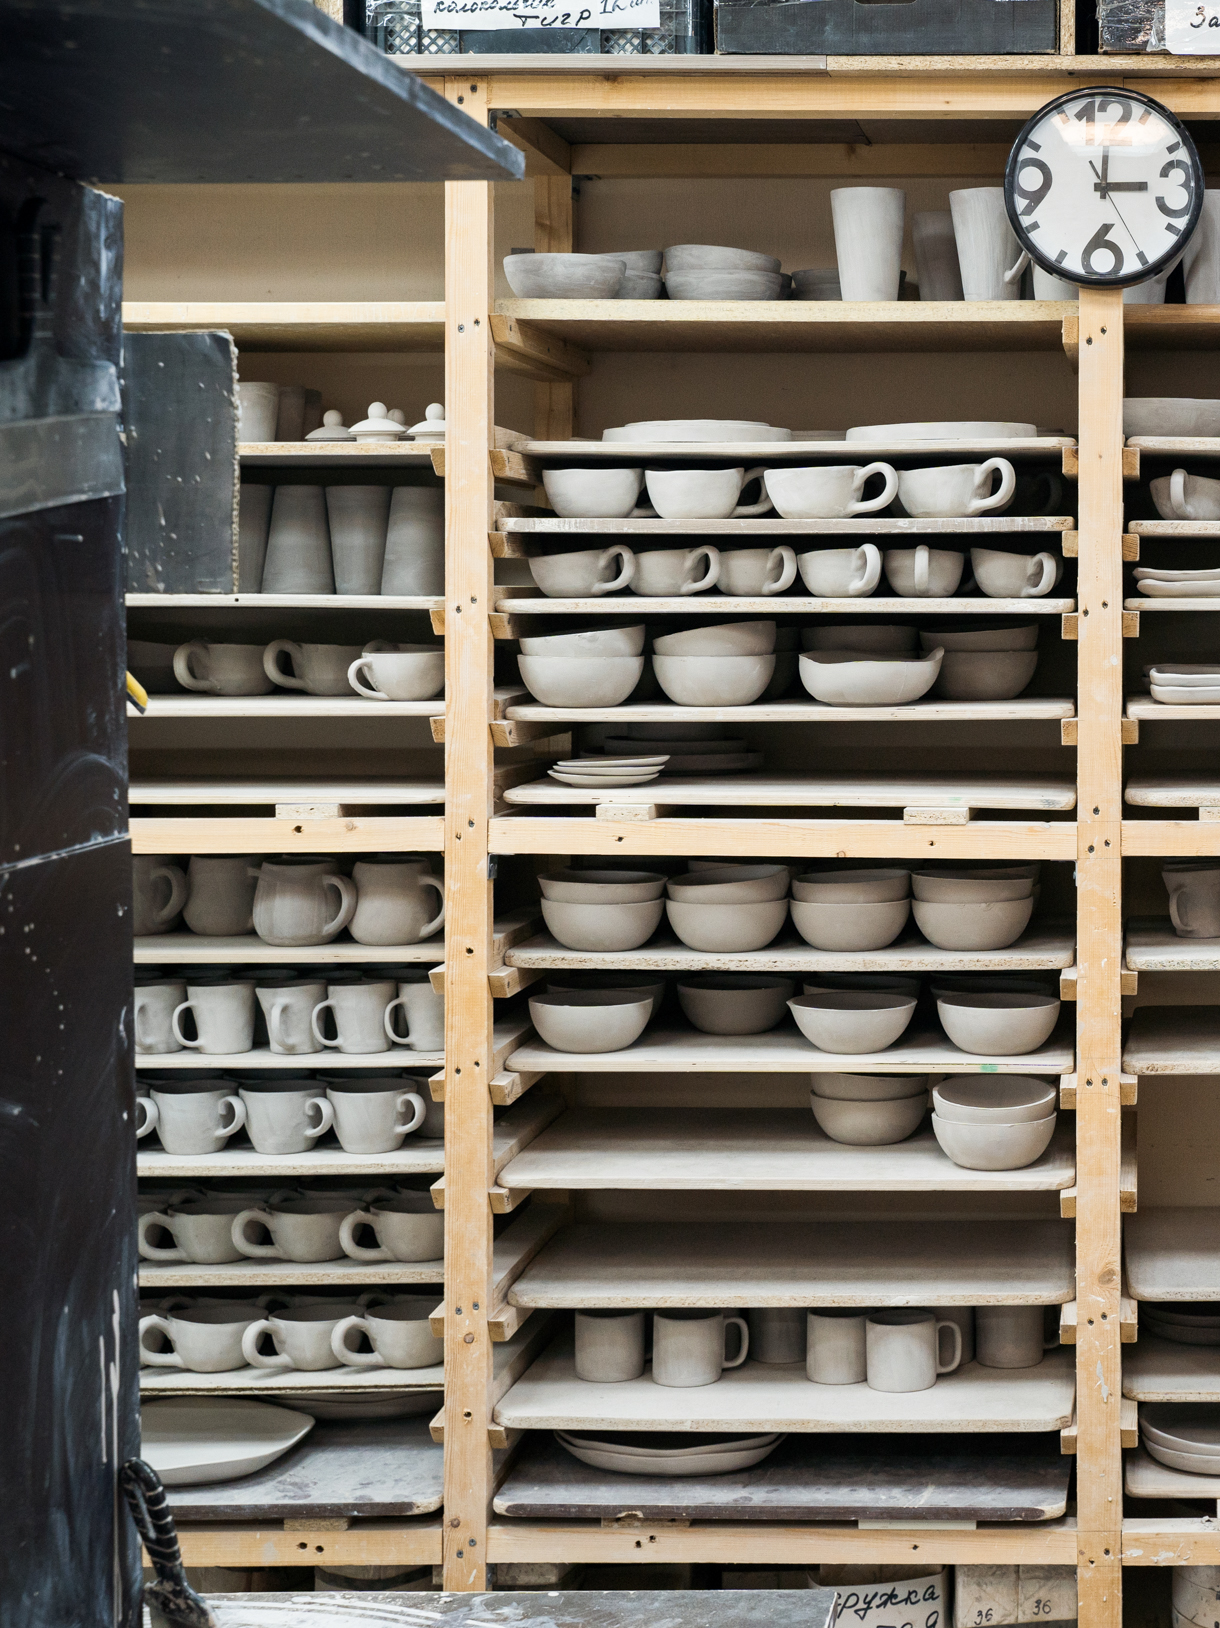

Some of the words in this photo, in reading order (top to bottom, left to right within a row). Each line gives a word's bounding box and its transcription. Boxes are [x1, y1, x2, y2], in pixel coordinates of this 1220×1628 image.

[1074, 99, 1133, 147] 12
[1017, 157, 1053, 216] 9
[1155, 159, 1194, 219] 3
[1081, 223, 1125, 274] 6
[974, 1608, 994, 1626] 36
[1033, 1599, 1052, 1616] 36
